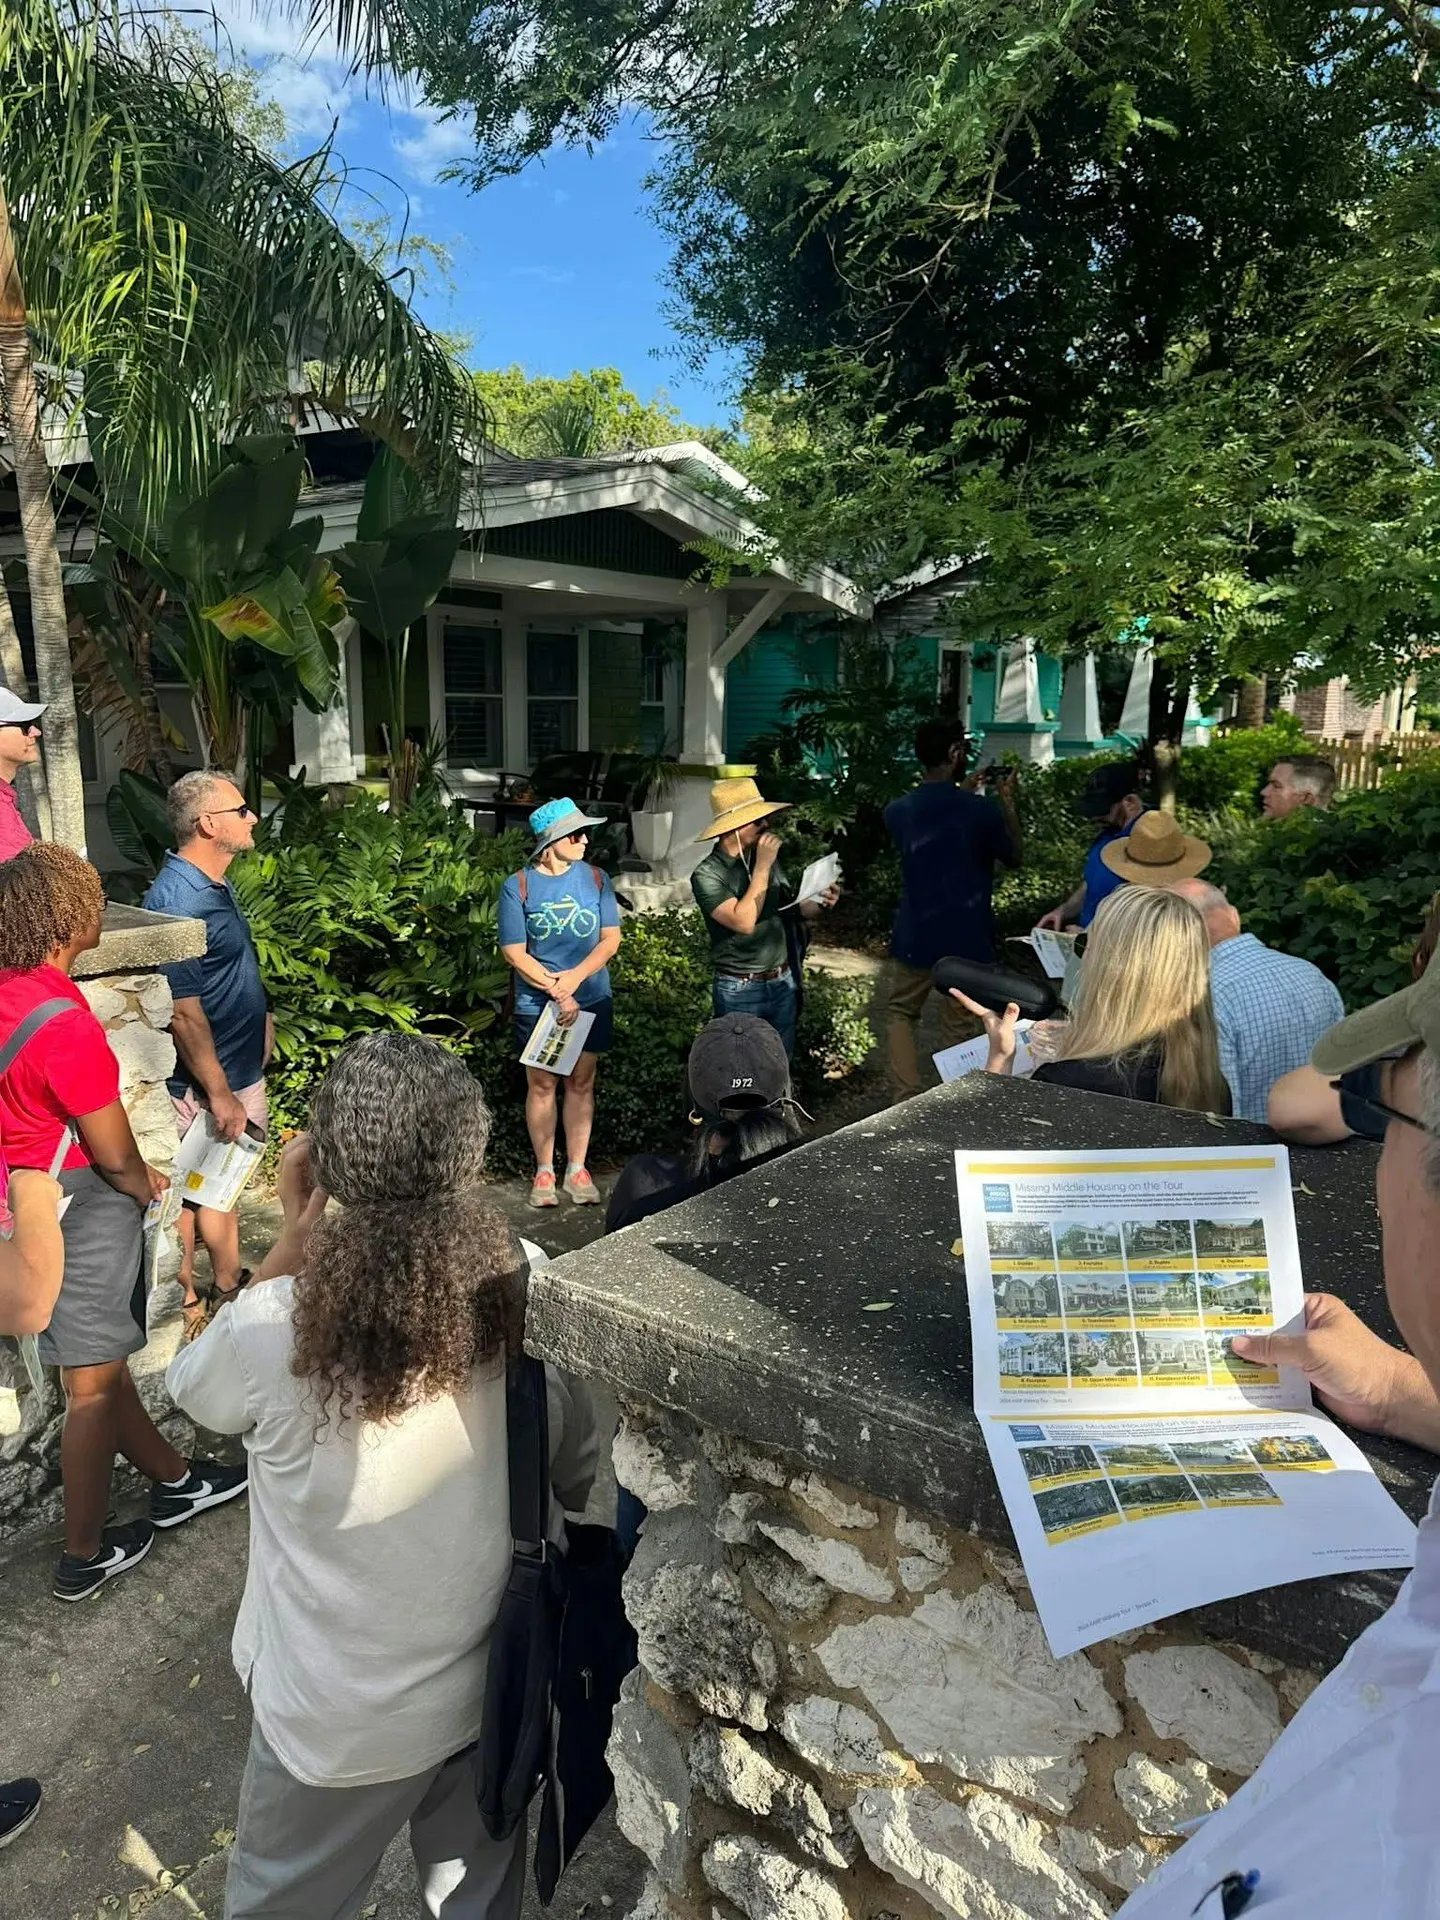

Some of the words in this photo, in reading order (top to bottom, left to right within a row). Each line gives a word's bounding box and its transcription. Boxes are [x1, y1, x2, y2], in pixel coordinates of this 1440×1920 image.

[731, 1077, 753, 1089] 1972
[1015, 1182, 1050, 1194] Missing
[1053, 1181, 1084, 1192] Middle
[1087, 1180, 1126, 1193] Housing
[1129, 1182, 1141, 1191] on
[1144, 1180, 1160, 1190] the
[1163, 1180, 1183, 1190] Tour
